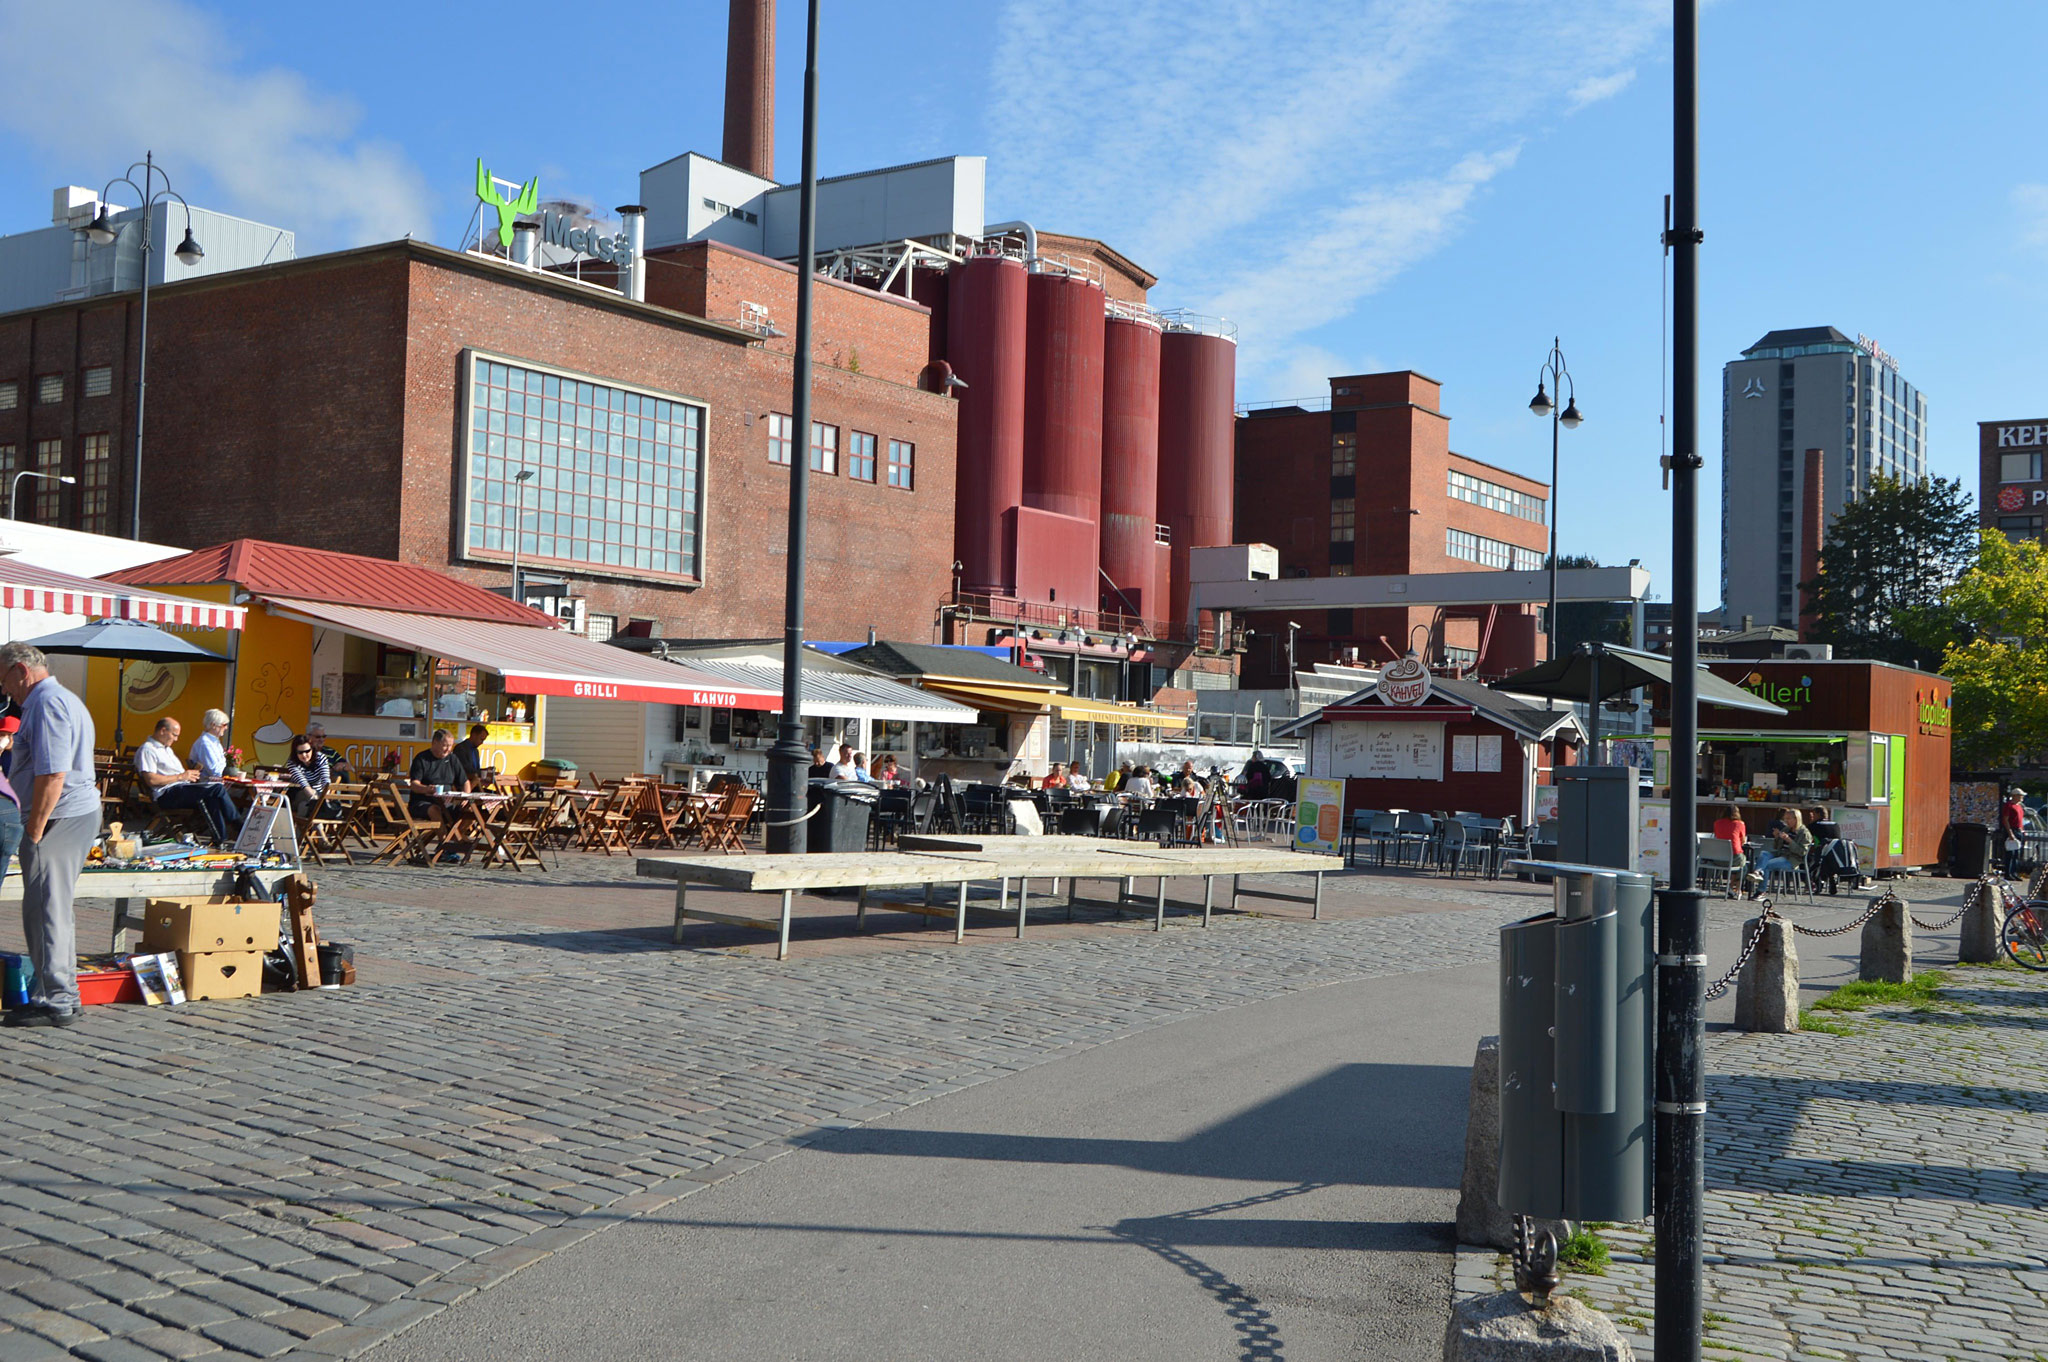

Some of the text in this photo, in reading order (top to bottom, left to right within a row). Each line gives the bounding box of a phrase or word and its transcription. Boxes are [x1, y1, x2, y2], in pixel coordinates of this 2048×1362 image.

[544, 209, 633, 268] Metsä
[574, 682, 737, 706] GRILLI KAHVIO
[1741, 675, 1812, 703] illeri
